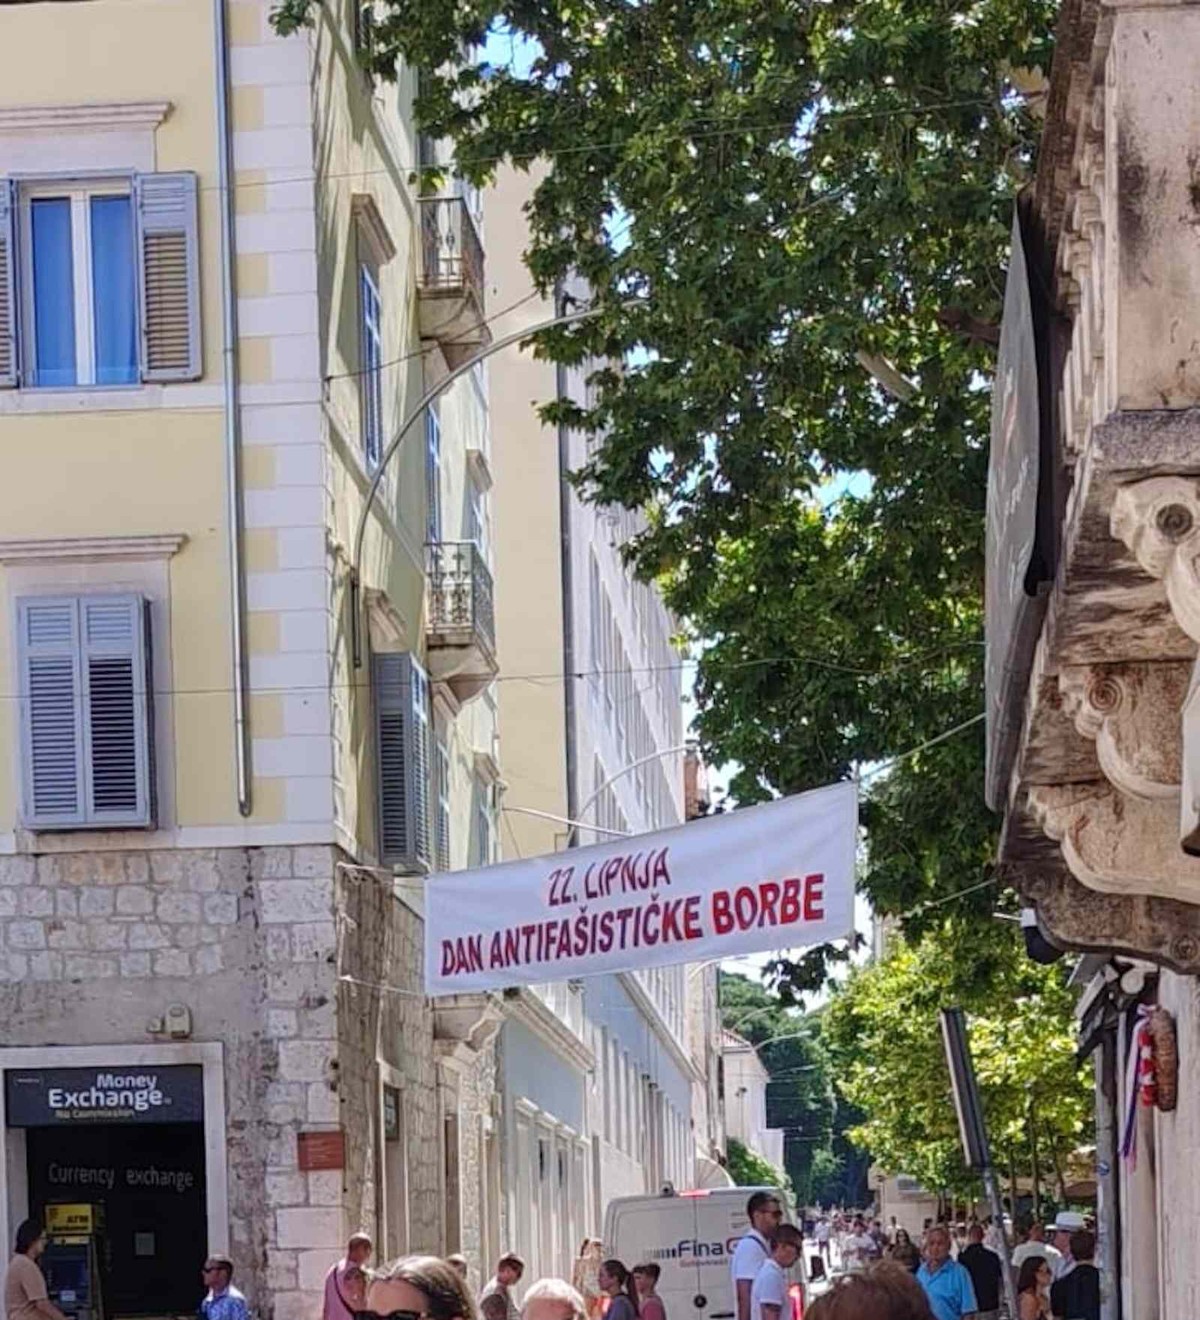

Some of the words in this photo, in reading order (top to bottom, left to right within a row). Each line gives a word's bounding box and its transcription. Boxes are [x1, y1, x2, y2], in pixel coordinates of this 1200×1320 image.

[548, 865, 578, 907] 22.
[585, 846, 671, 899] LIPNJA
[441, 933, 484, 977] DAN
[489, 893, 703, 968] ANTIFAŠISTIČKE
[711, 873, 825, 936] BORBE
[97, 1073, 157, 1090] Money
[49, 1087, 163, 1111] Exchange
[49, 1163, 115, 1190] Currency
[126, 1166, 194, 1192] exchange
